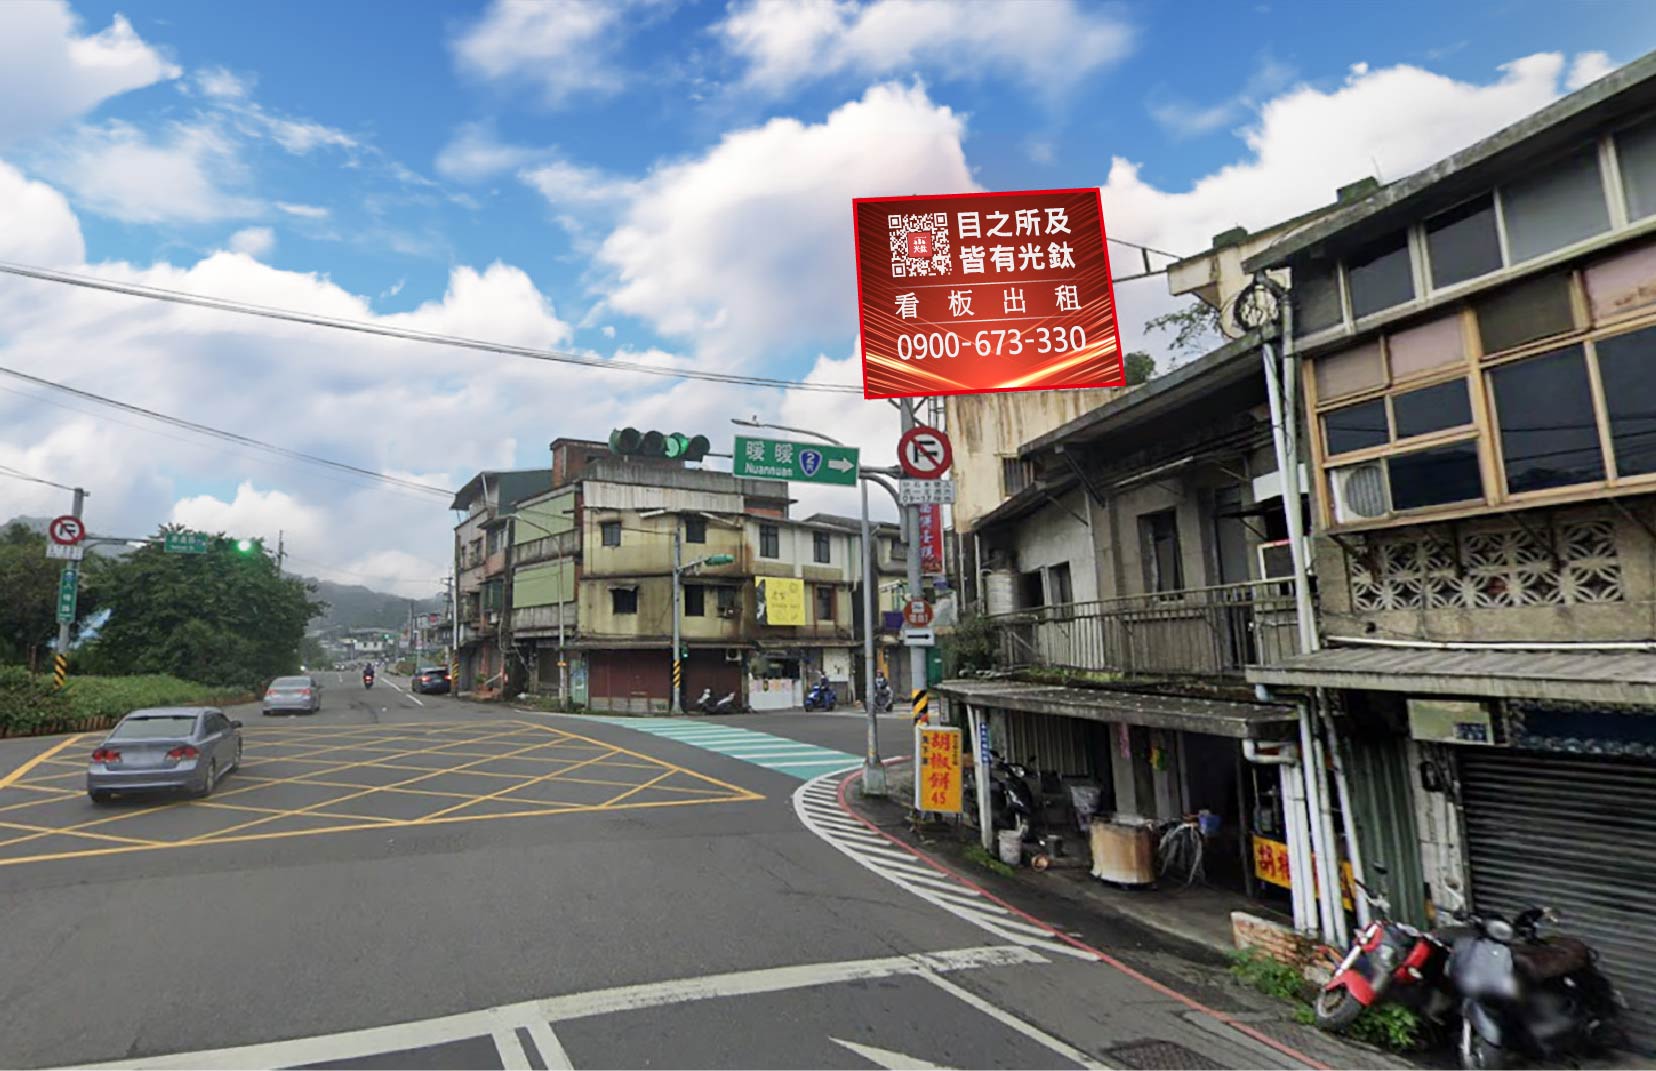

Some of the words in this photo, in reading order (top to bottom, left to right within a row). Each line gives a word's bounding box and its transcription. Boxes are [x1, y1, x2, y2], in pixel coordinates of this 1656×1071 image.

[957, 207, 1072, 239] 目之所及
[959, 241, 1076, 274] 皆有光鈦
[894, 284, 1082, 320] 看板出租
[897, 325, 1087, 361] 0900-673-330
[928, 732, 951, 791] 胡椒餅
